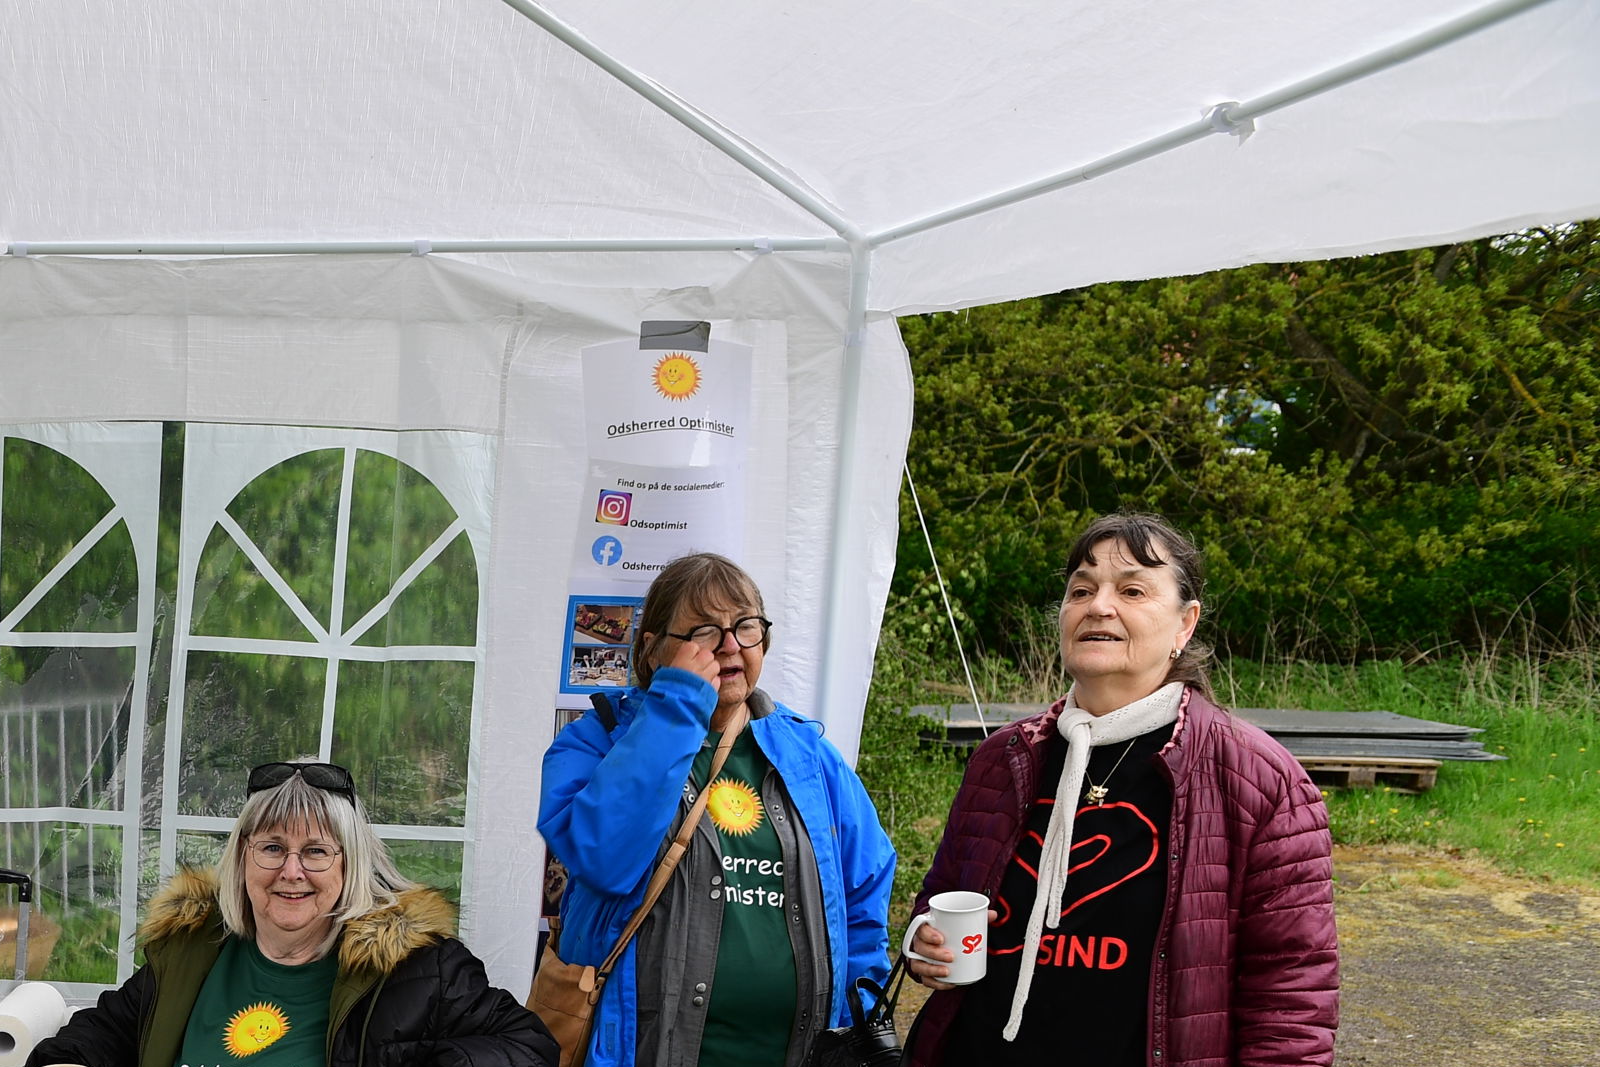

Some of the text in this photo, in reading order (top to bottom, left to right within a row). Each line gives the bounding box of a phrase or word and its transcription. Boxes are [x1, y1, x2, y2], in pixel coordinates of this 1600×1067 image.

[607, 416, 734, 436] Odsherred Optimister
[617, 478, 635, 489] Find
[648, 480, 659, 491] på
[661, 481, 672, 491] de
[630, 519, 688, 531] Odsoptimist
[622, 561, 667, 571] Odsherre
[1037, 934, 1128, 970] SIND
